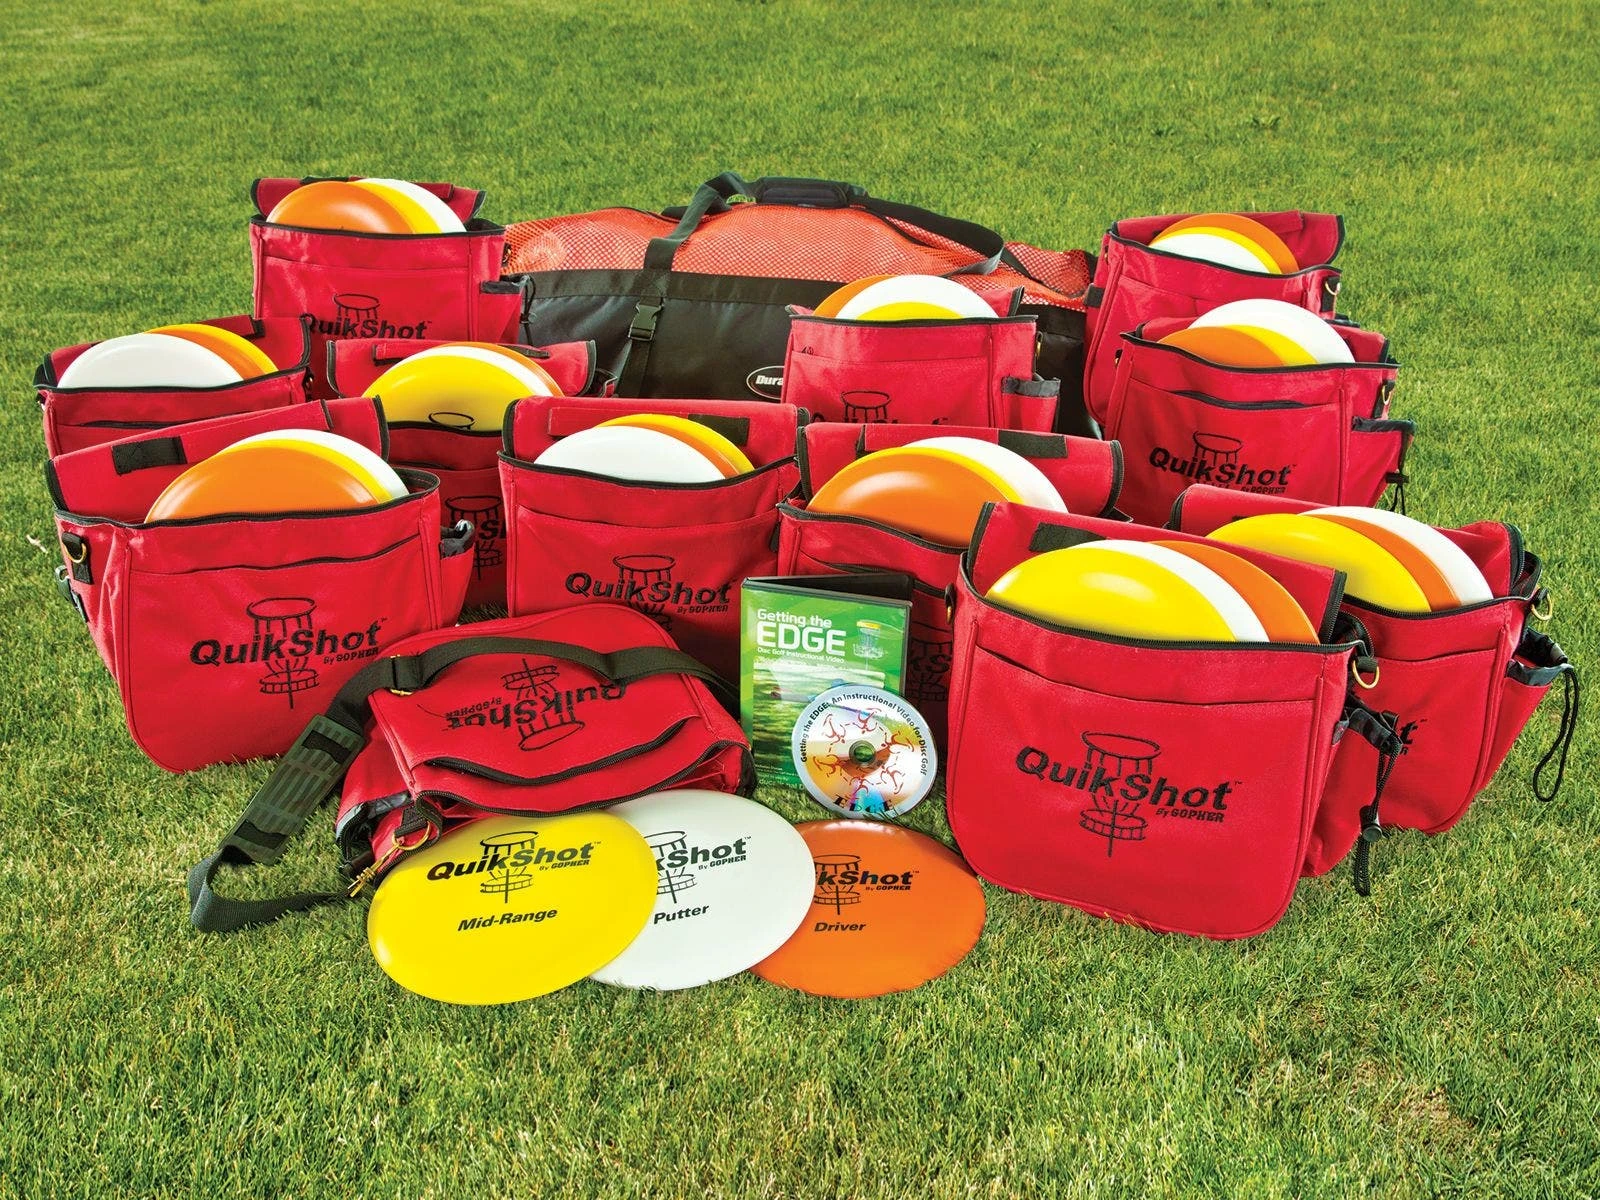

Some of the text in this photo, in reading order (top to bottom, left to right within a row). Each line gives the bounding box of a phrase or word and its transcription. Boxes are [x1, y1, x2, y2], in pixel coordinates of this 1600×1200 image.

[1149, 446, 1292, 486] QuikShot
[565, 572, 732, 605] QuikShot
[689, 605, 729, 615] GOPHER
[757, 608, 832, 629] Getting the
[189, 620, 382, 667] QuikShot
[756, 620, 847, 657] EDGE
[336, 647, 380, 663] GOPHER
[757, 647, 771, 655] Disc
[772, 648, 785, 656] Golf
[786, 650, 825, 661] Instructional
[826, 656, 845, 664] Video
[832, 695, 843, 705] An
[843, 693, 898, 710] Instructional
[895, 706, 915, 728] Video
[803, 720, 813, 733] the
[912, 726, 923, 742] for
[800, 733, 810, 763] Getting
[918, 740, 928, 757] Disc
[920, 758, 929, 776] Golf
[1015, 745, 1233, 811] QuikShot
[1171, 808, 1225, 823] GOPHER
[426, 842, 595, 881] QuikShot
[655, 838, 747, 872] kShot
[710, 855, 747, 868] GOPHER
[551, 858, 590, 870] GOPHER
[817, 870, 914, 886] kShot
[457, 908, 558, 932] Mid-Range
[653, 905, 710, 925] Putter
[814, 922, 867, 932] Driver
